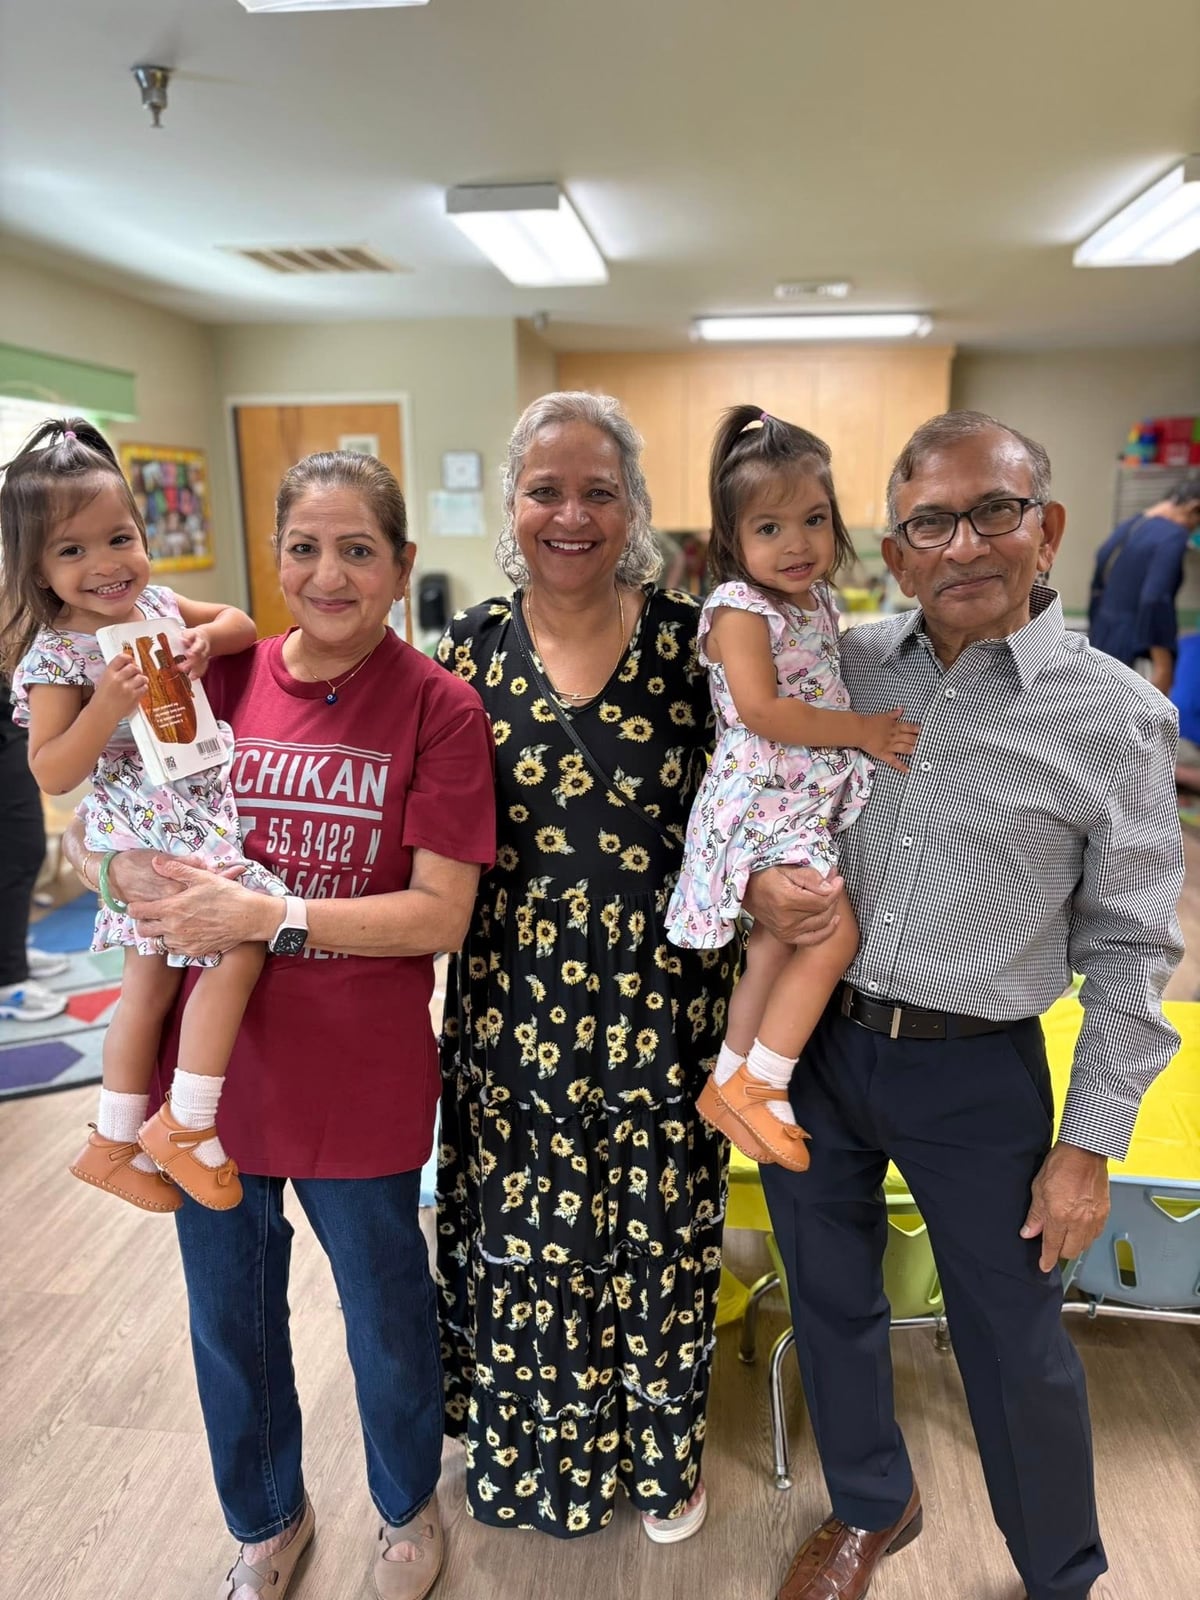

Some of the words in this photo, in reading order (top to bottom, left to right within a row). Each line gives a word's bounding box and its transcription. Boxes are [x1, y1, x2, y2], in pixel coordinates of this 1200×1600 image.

[234, 749, 389, 807] CHIKAN
[266, 817, 355, 863] 55.3422
[364, 828, 382, 865] N
